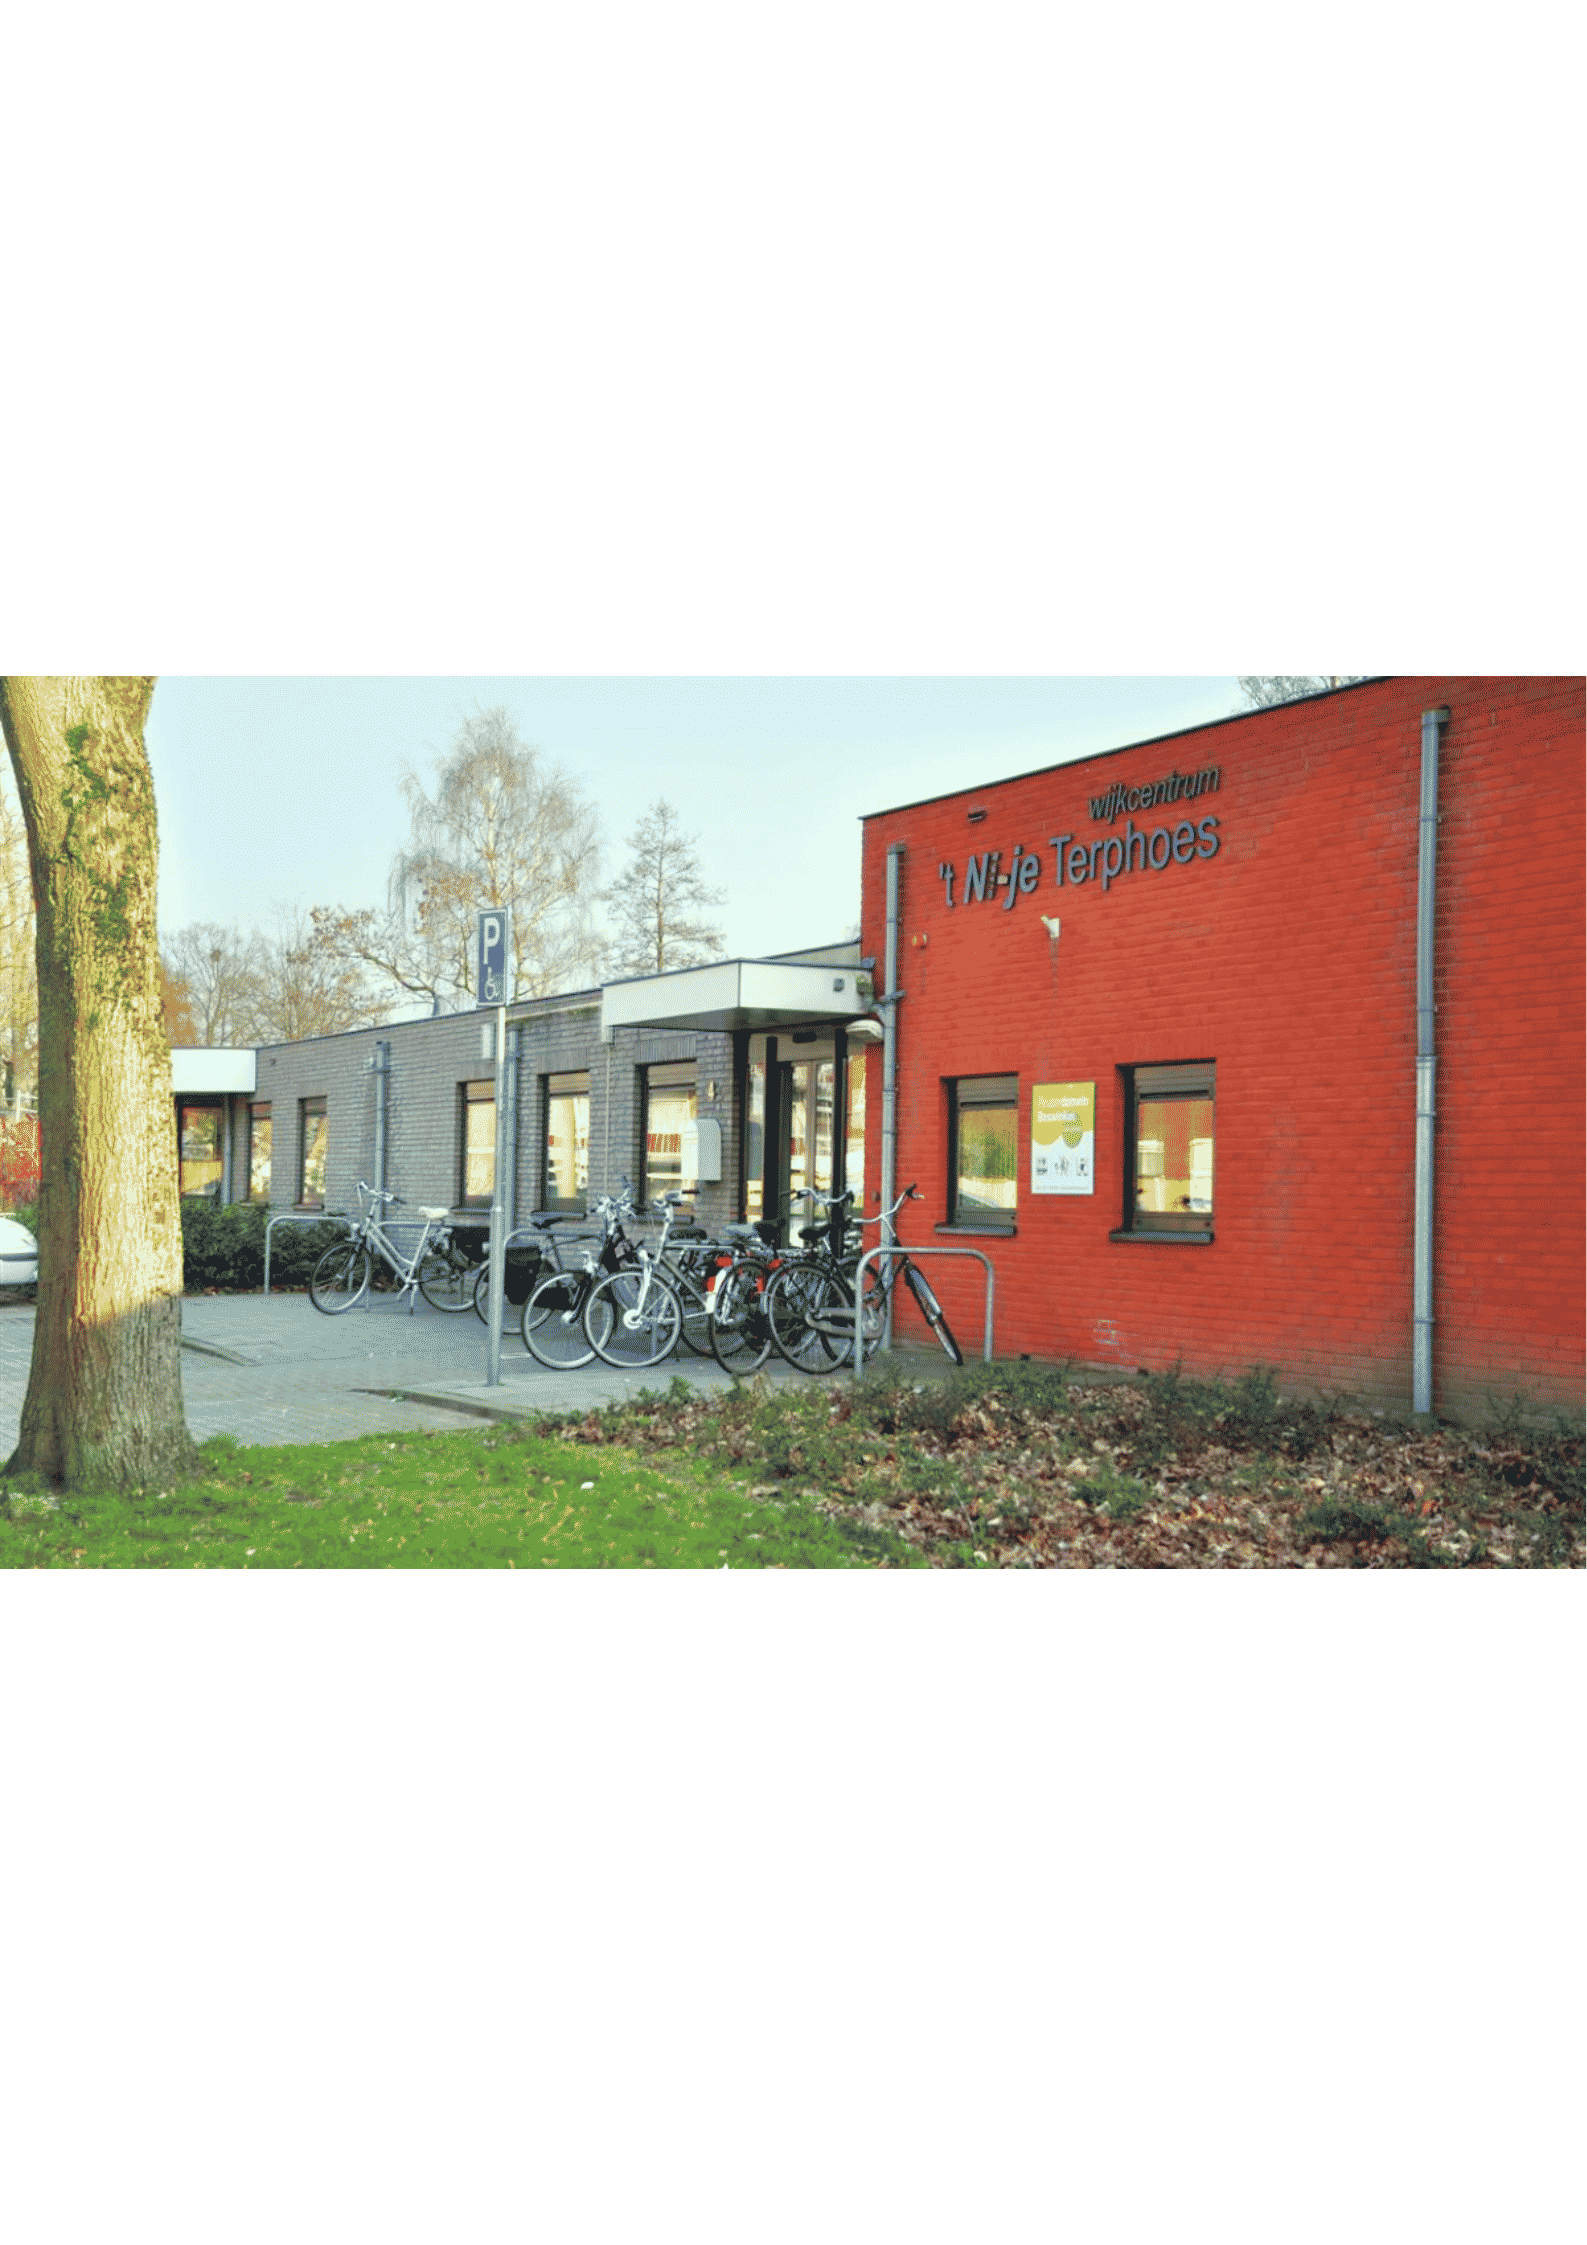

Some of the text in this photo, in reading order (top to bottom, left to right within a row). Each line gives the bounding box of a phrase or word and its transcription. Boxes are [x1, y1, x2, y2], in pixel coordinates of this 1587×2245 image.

[1088, 766, 1220, 824] wijkcentrum
[938, 862, 955, 907] 't
[1049, 815, 1220, 892] Terphoes
[483, 917, 500, 965] P
